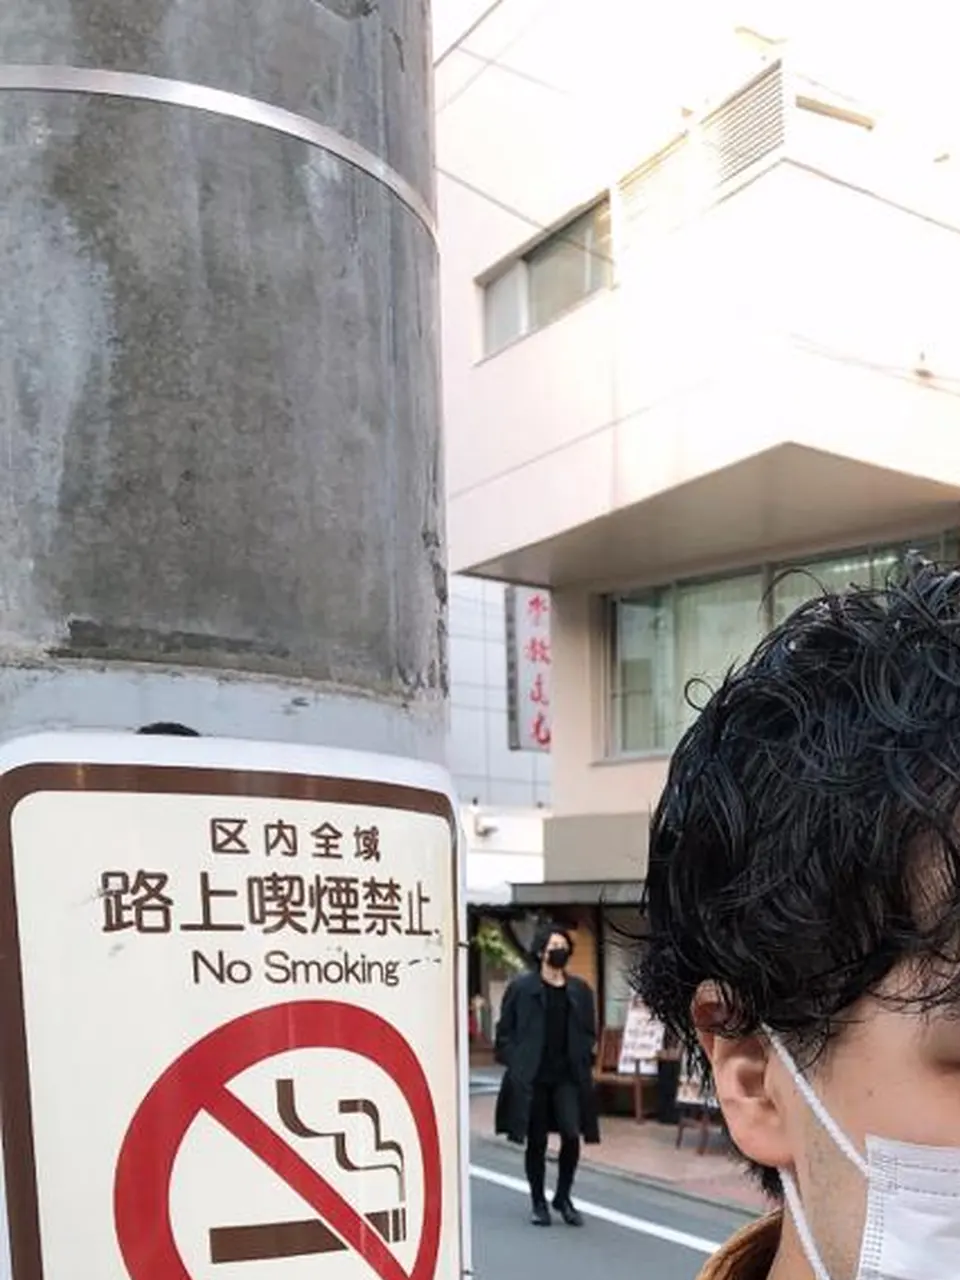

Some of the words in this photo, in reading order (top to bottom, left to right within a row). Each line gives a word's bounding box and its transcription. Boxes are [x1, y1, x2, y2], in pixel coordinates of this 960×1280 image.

[209, 817, 382, 862] 区内全域
[100, 869, 433, 937] 路上喫煙禁止
[192, 950, 252, 984] No
[264, 950, 400, 987] Smoking
